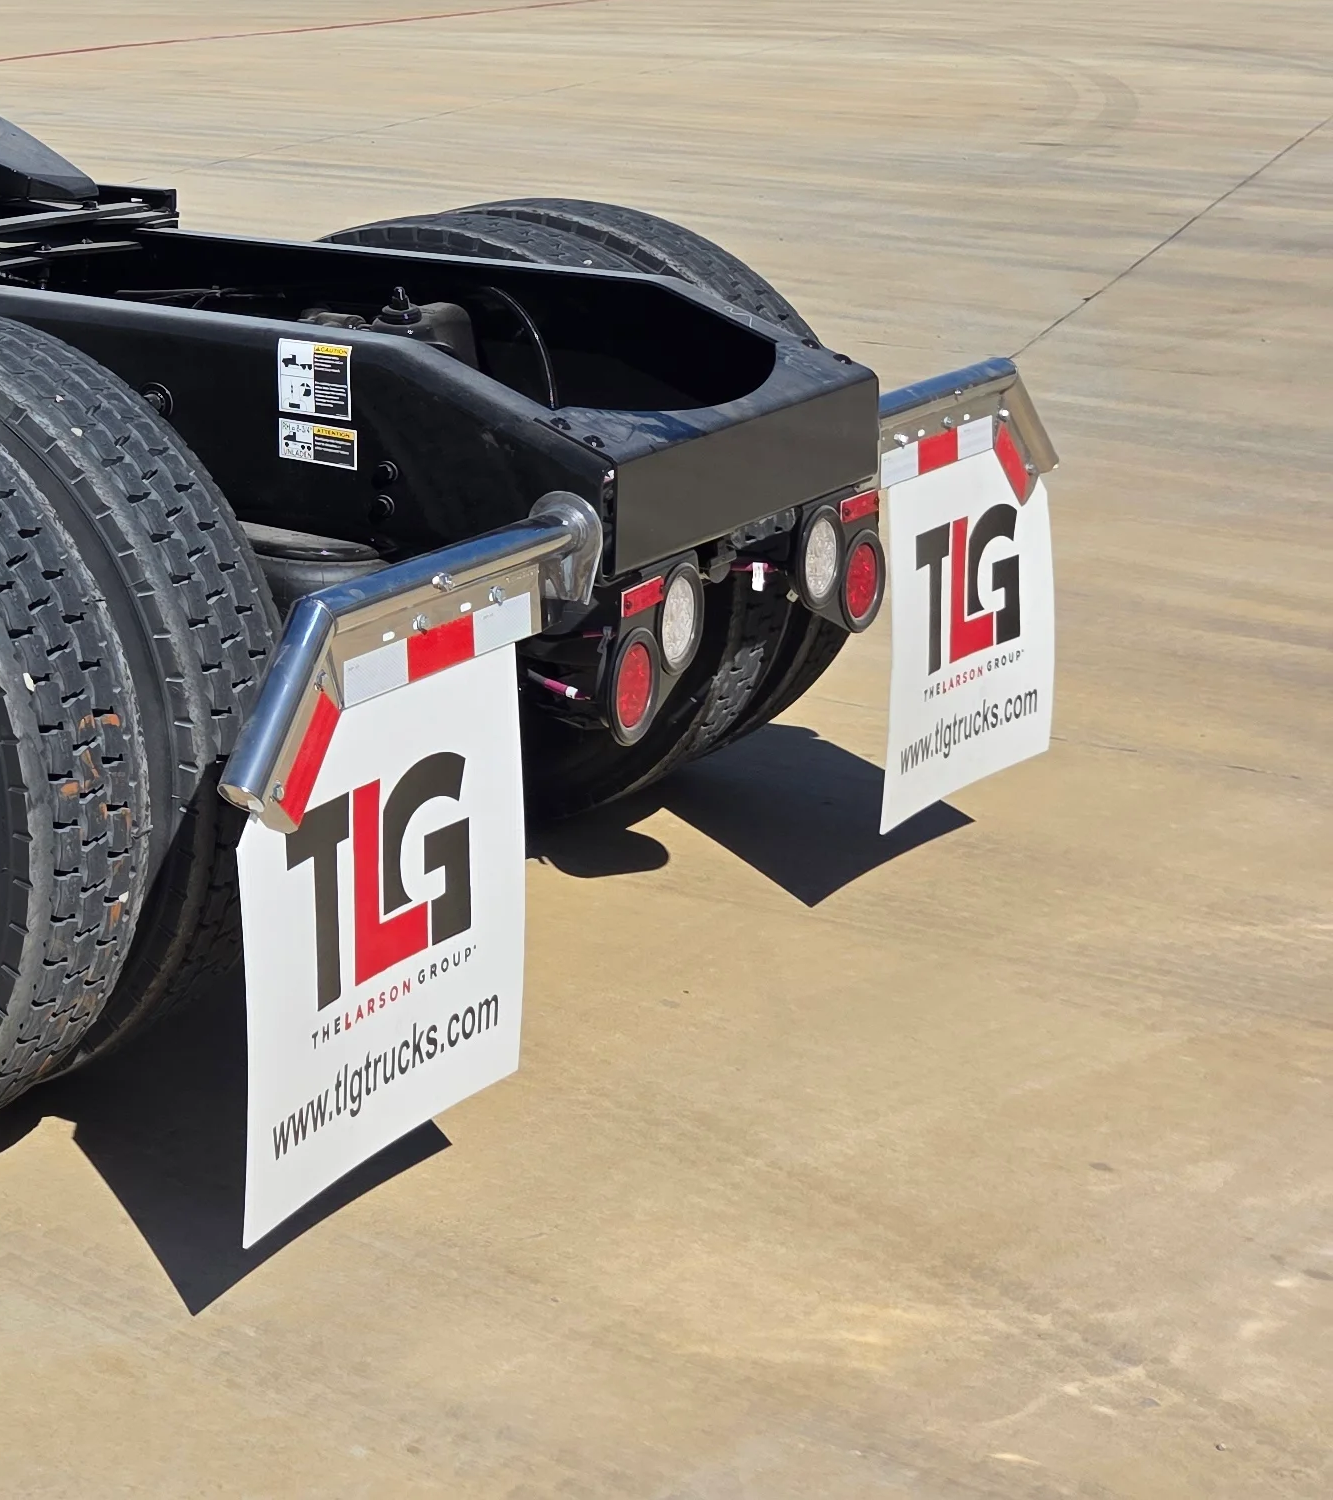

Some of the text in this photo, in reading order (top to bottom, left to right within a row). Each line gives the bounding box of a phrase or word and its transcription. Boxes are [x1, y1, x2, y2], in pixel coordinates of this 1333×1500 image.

[320, 346, 348, 355] CAUTION
[316, 428, 351, 438] ATTENTION
[284, 448, 312, 459] UNLADEN
[916, 503, 1021, 676] TLG
[986, 650, 1022, 672] GROUP
[900, 687, 1038, 776] www.tlgtrucks.com
[285, 751, 472, 1011] TLG
[417, 946, 472, 985] GROUP
[272, 993, 500, 1161] www.tlgtrucks.com
